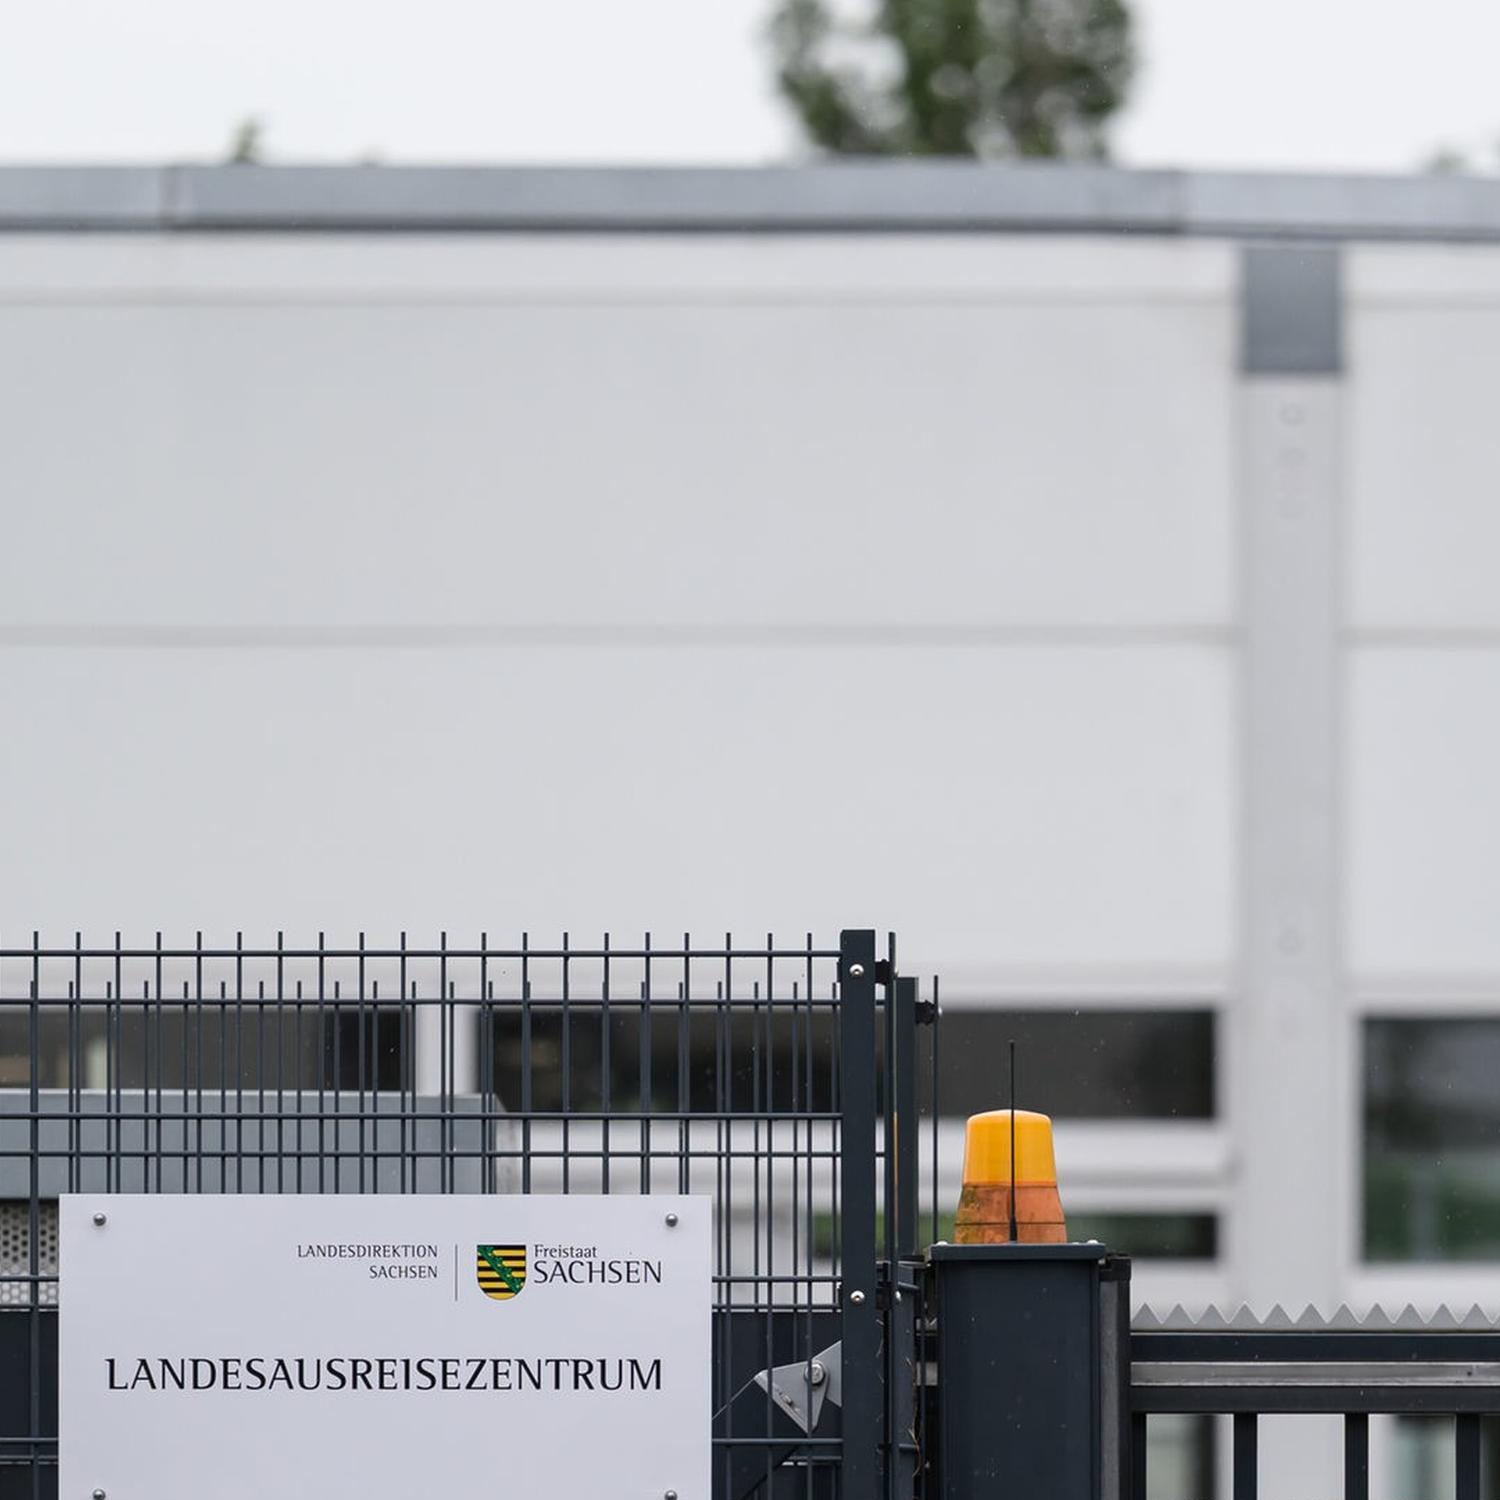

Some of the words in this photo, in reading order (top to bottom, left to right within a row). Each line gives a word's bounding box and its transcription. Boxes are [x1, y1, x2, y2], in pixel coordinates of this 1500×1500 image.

[298, 1244, 437, 1258] LANDESDIREKTION
[534, 1244, 597, 1259] Freistaat
[369, 1264, 438, 1279] SACHSEN
[533, 1260, 662, 1284] SACHSEN
[105, 1358, 662, 1391] LANDESAUSREISEZENTRUM
